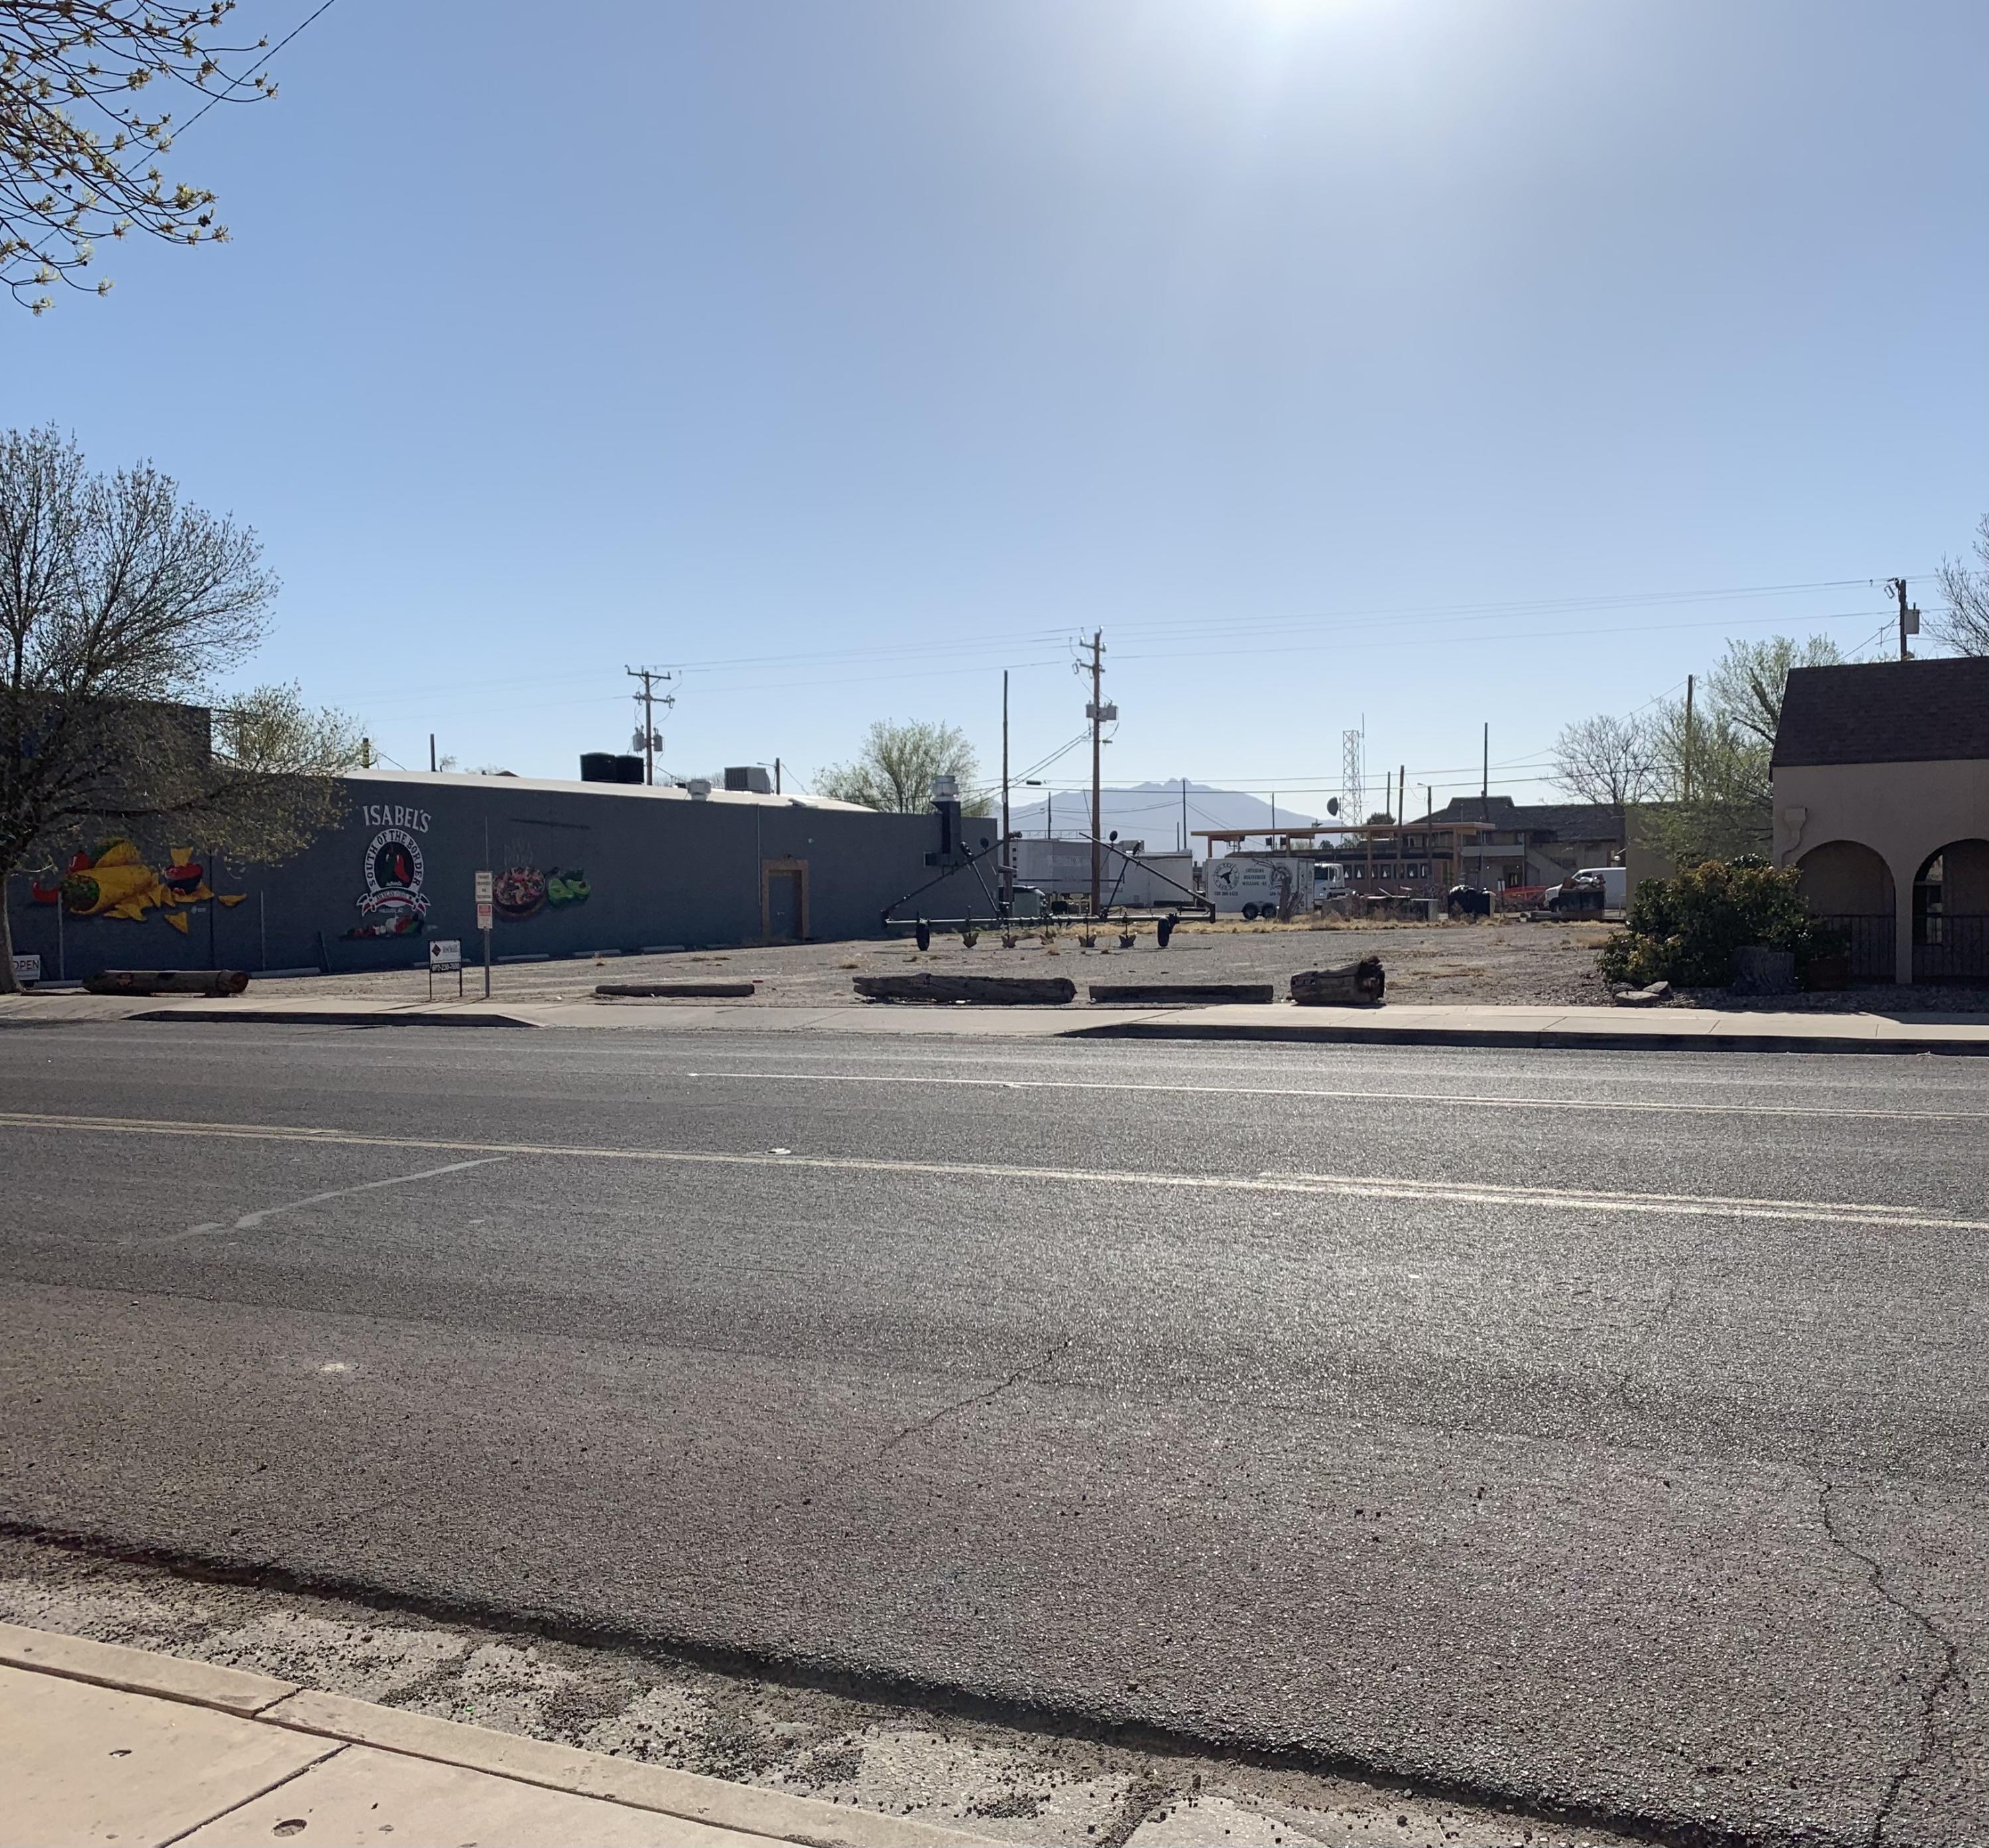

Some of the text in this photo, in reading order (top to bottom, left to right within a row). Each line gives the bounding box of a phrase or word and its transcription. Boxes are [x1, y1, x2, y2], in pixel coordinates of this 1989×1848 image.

[363, 805, 432, 833] ISABEL'S
[366, 830, 423, 887] SOUTH OF THE BORDER
